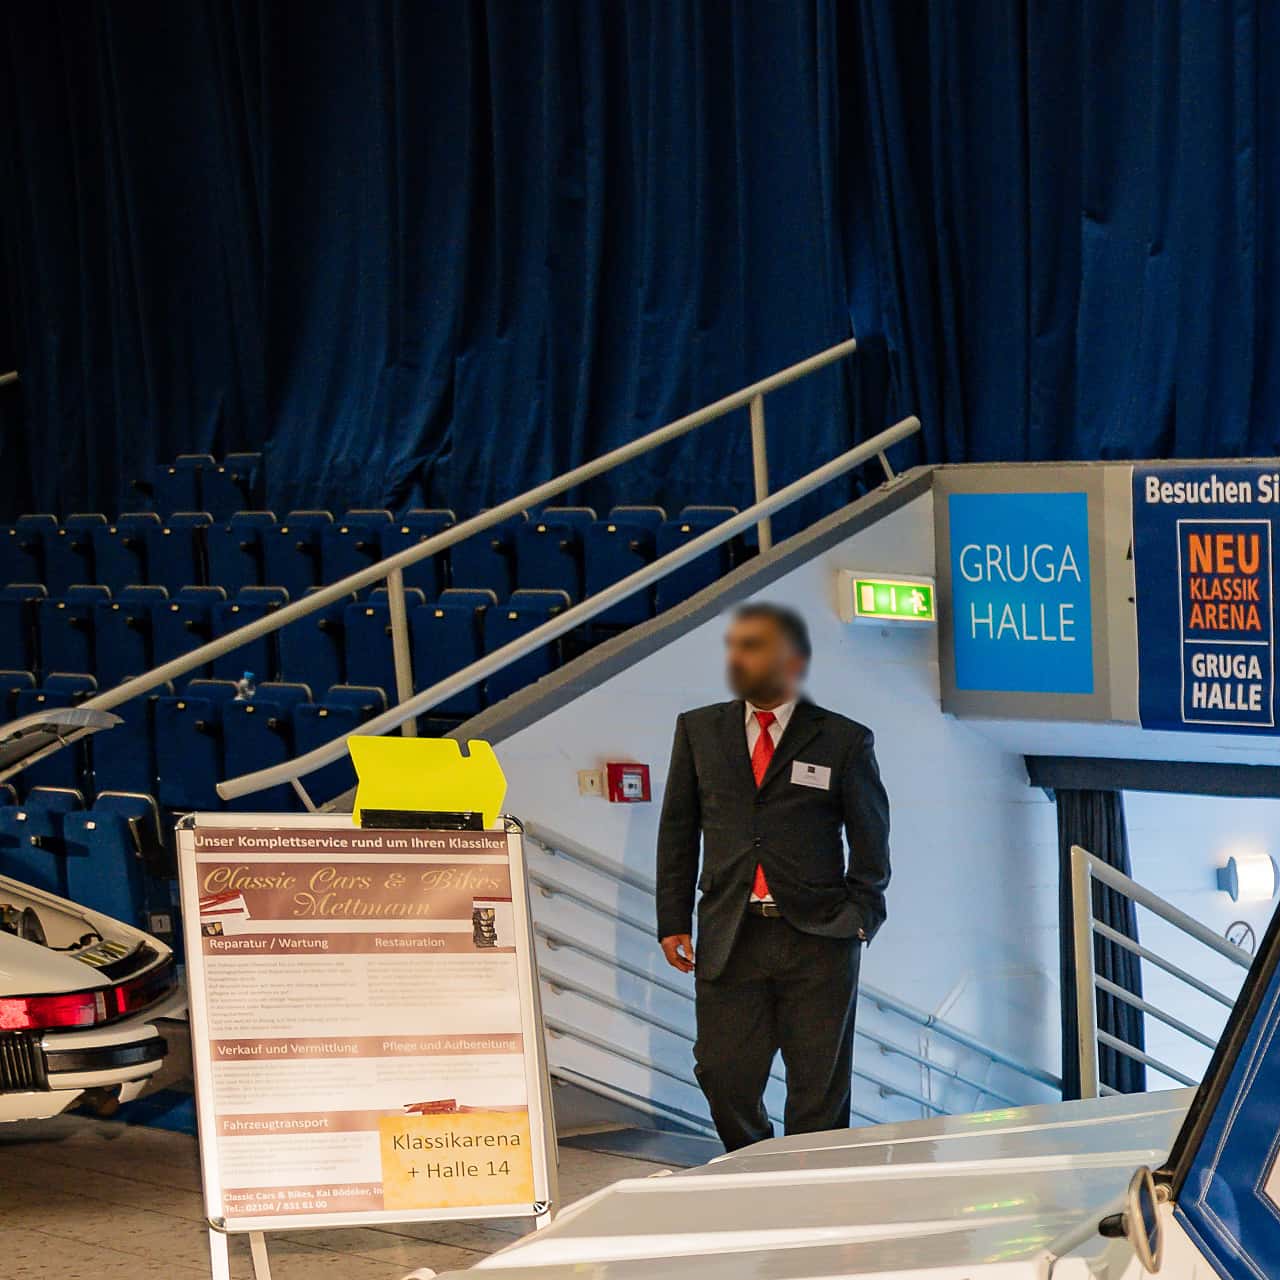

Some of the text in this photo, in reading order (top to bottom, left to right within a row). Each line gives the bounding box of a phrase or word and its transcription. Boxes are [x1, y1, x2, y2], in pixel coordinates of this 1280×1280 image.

[1145, 474, 1252, 503] Besuchen
[959, 544, 1081, 582] GRUGA
[1188, 533, 1260, 574] NEU
[1189, 578, 1260, 601] KLASSIK
[970, 602, 1076, 641] HALLE
[1188, 603, 1262, 631] ARENA
[1191, 653, 1263, 680] GRUGA
[1191, 682, 1262, 711] HALLE
[195, 836, 505, 849] Unser Komplettservice rund um Ihren Klassiker
[204, 867, 502, 893] Classic Cars & Bikes
[293, 892, 431, 916] Mettmann
[209, 938, 267, 951] Reparatur
[278, 938, 329, 950] Wartung
[375, 937, 445, 948] Restauration
[217, 1041, 359, 1055] Verkauf und Vermittlung
[420, 1039, 441, 1050] und
[444, 1038, 517, 1051] Aufbereitung
[223, 1117, 329, 1131] Fahrzeugtransport
[393, 1131, 521, 1150] Klassikarena
[407, 1160, 511, 1178] + Halle 14
